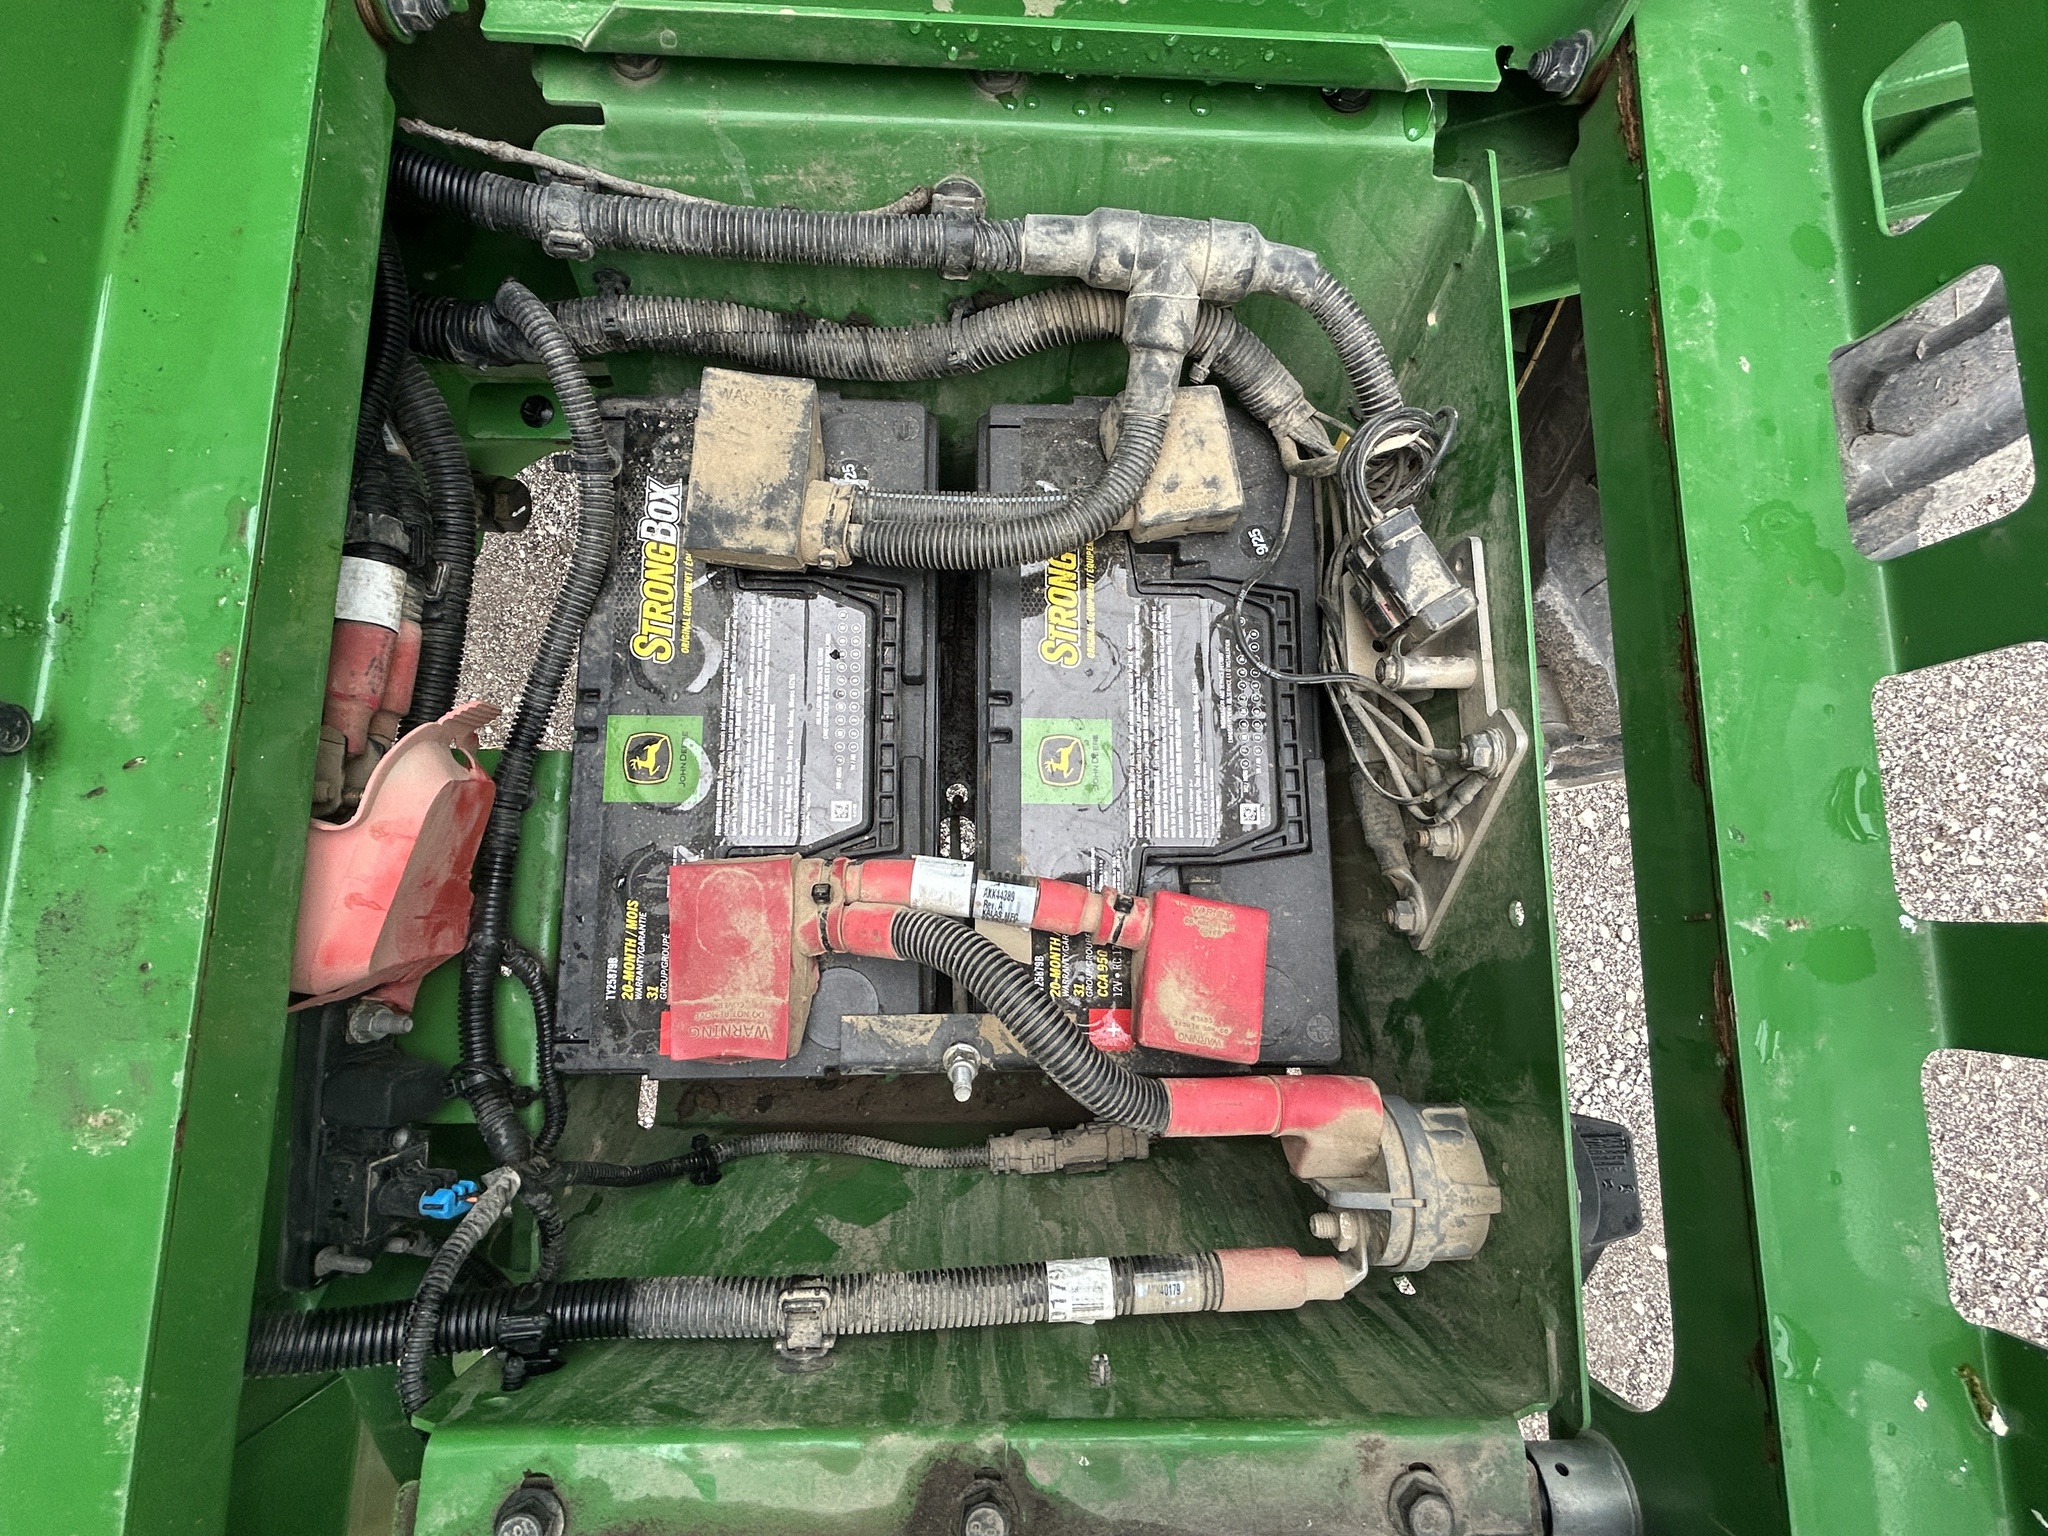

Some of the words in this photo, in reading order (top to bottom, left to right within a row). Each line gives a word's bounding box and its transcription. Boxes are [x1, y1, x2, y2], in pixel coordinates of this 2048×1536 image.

[1248, 528, 1268, 555] 9/25
[1085, 541, 1094, 573] ÉQUIPE
[683, 572, 692, 616] EQUIPMENT
[1038, 548, 1081, 668] STRONG
[1086, 578, 1095, 622] EQUIPMENT
[681, 618, 691, 653] ORIGINAL
[1086, 624, 1095, 658] ORIGINAL
[679, 763, 687, 787] JOHN
[626, 899, 639, 929] MOIS
[635, 912, 647, 1000] WARRANTY/GARANTIE
[1097, 949, 1109, 971] 950
[1112, 946, 1121, 955] 17
[1112, 958, 1122, 970] RC
[605, 957, 618, 1000] TY25879B
[622, 938, 636, 1000] 20-MONTH
[1034, 955, 1045, 991] 25879B
[1050, 937, 1061, 997] 20-MONTH
[646, 985, 659, 1000] 31
[1073, 983, 1085, 997] 31
[1097, 974, 1109, 997] CCA
[1113, 980, 1122, 996] 12V
[695, 1011, 729, 1020] REMOVE
[688, 1024, 770, 1039] WARNING
[1178, 1032, 1222, 1047] WARNING
